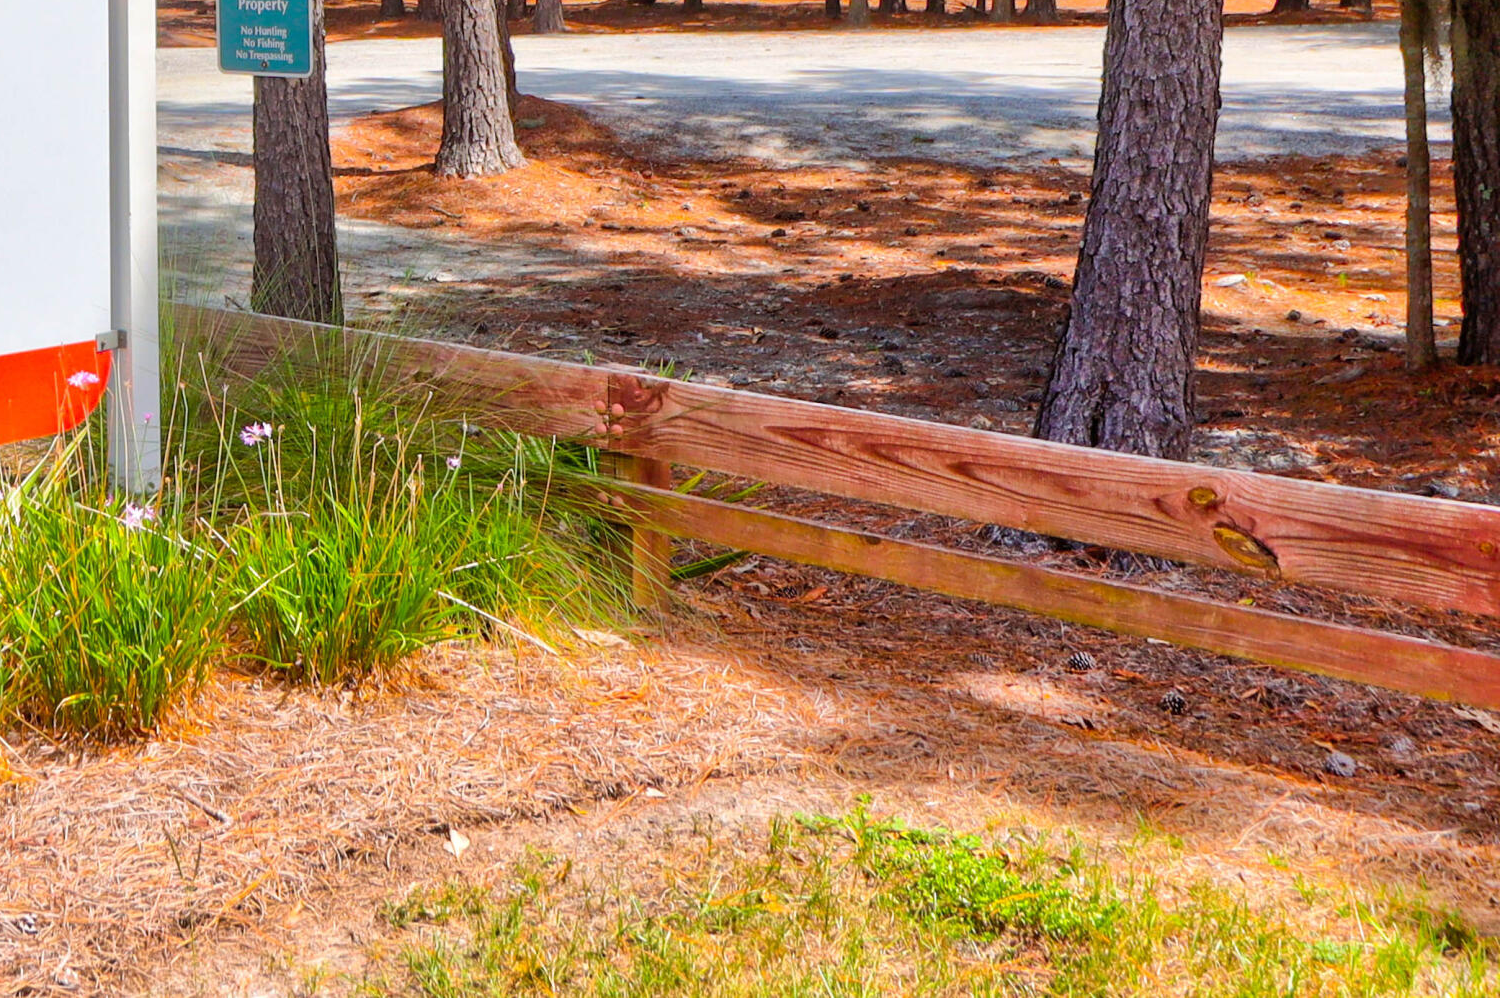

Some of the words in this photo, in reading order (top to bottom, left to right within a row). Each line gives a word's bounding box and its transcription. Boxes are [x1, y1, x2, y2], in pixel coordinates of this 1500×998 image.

[240, 25, 253, 35] No
[254, 25, 288, 39] Hunting
[243, 37, 255, 48] No
[257, 37, 286, 51] Fishing
[235, 49, 248, 59] No
[249, 49, 294, 64] Trespassing
